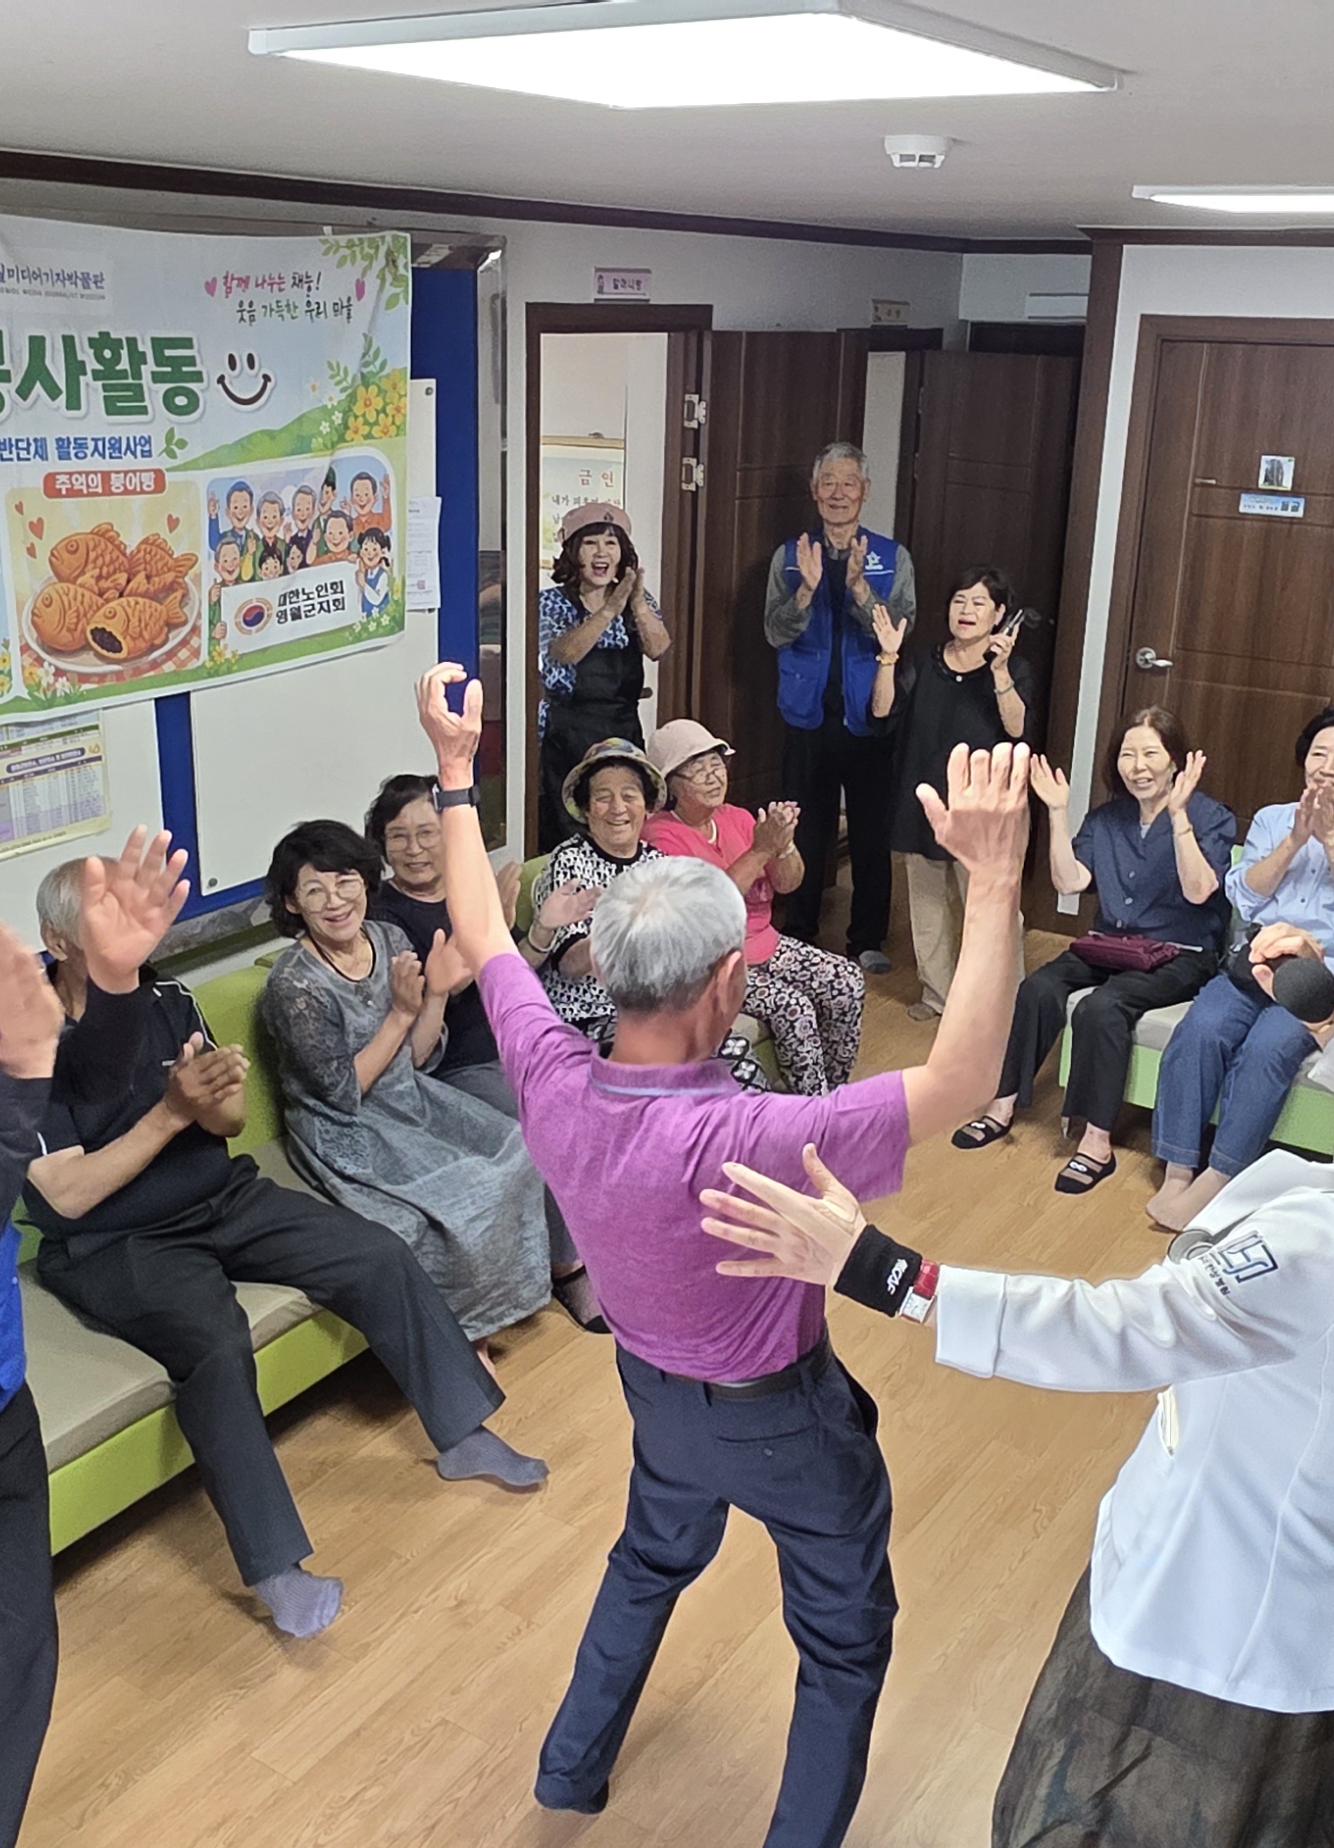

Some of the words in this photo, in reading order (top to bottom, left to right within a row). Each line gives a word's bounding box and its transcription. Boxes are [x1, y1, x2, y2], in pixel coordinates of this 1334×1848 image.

[223, 271, 251, 299] 함께
[255, 272, 286, 293] 나누는
[236, 300, 256, 326] 웃음
[261, 302, 299, 322] 가득한
[305, 300, 328, 323] 우리
[333, 296, 353, 324] 마을
[55, 434, 153, 461] 활동지원사업
[55, 472, 101, 494] 추억의
[277, 580, 345, 606] 대한노인회
[276, 596, 346, 625] 영월군지회
